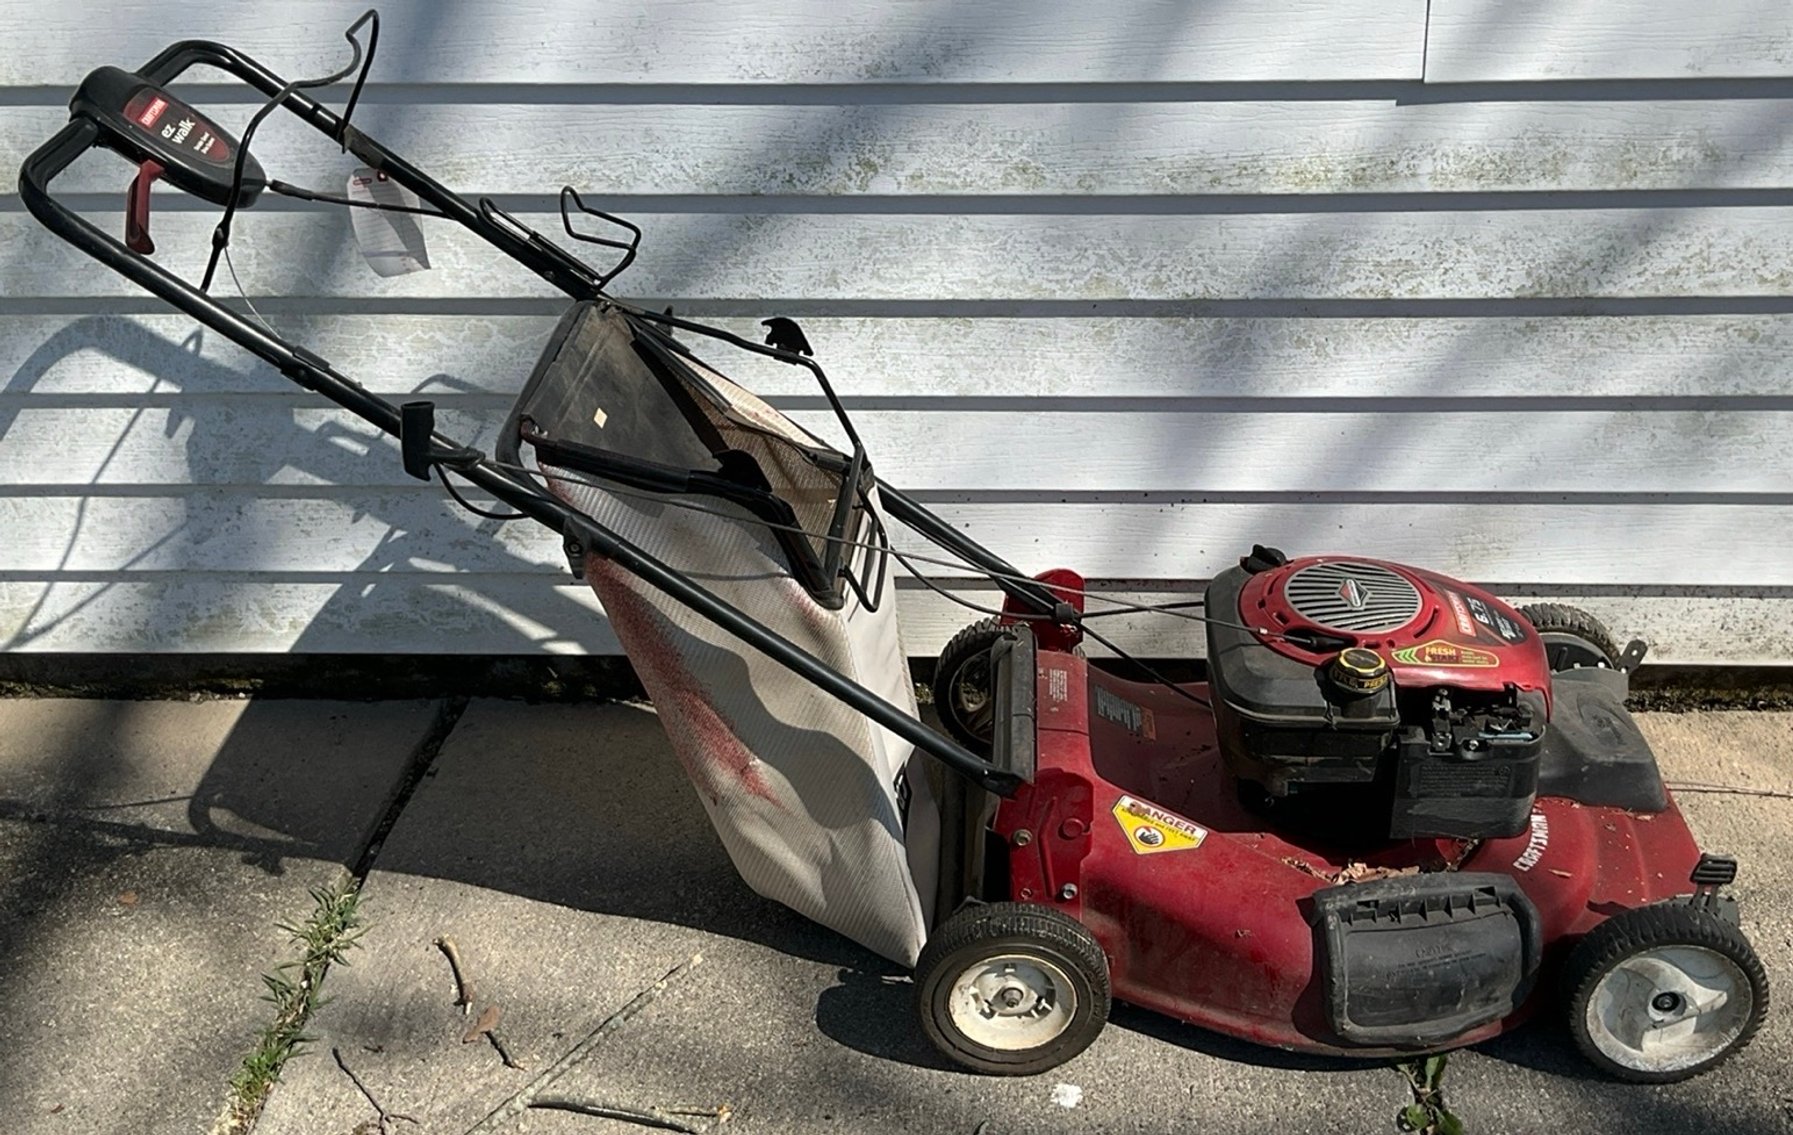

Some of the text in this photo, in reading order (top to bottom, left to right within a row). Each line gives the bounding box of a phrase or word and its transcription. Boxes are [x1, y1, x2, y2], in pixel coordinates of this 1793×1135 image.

[161, 124, 176, 138] ez
[172, 117, 196, 144] walk
[1466, 596, 1490, 625] 6.75
[1424, 646, 1456, 656] FRESH
[1129, 801, 1197, 836] ANGER
[1512, 814, 1549, 872] CRAFTSMAN
